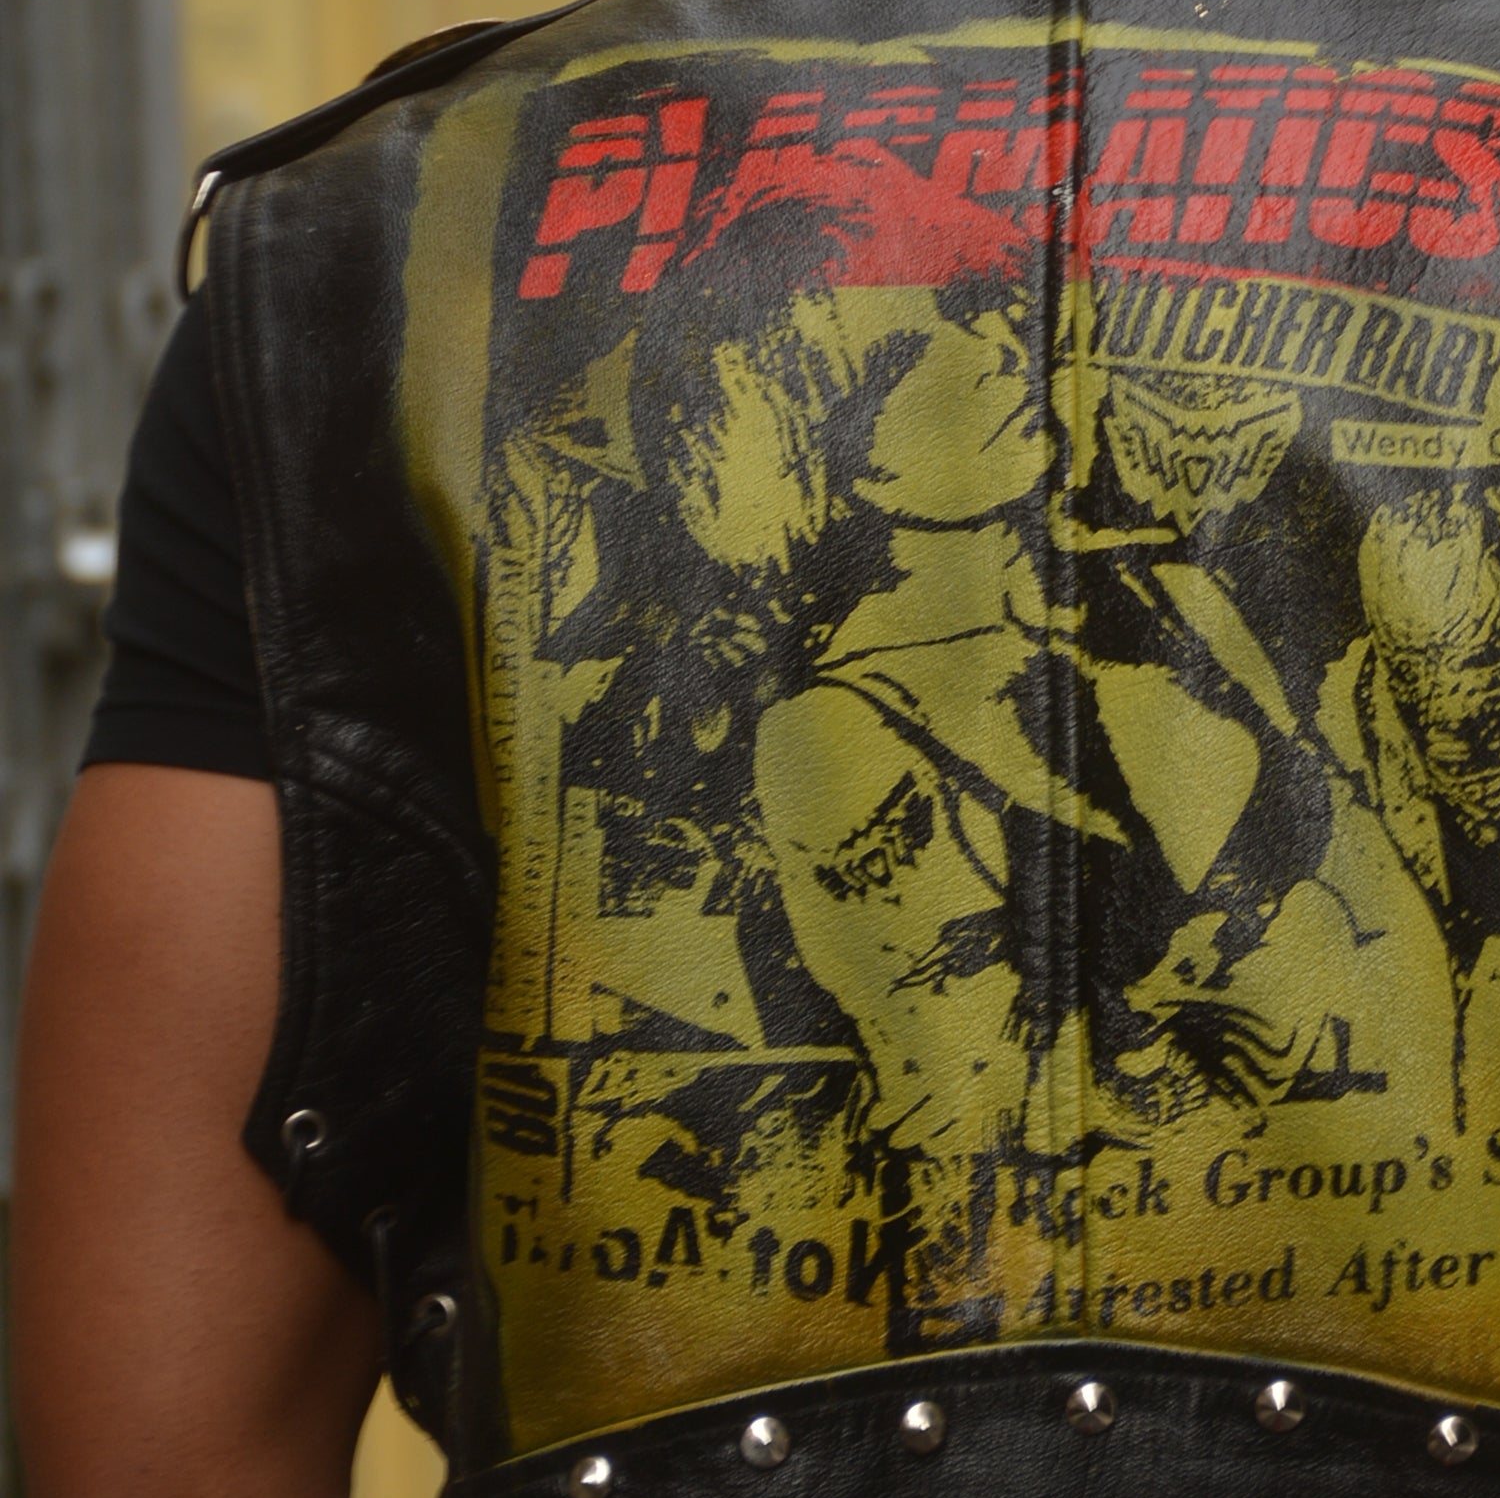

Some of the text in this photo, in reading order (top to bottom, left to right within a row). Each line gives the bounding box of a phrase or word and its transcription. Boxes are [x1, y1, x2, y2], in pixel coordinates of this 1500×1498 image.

[1341, 426, 1467, 469] Wendy
[1205, 1133, 1453, 1214] Group's
[1020, 1245, 1297, 1327] Arrested
[1328, 1239, 1495, 1311] After
